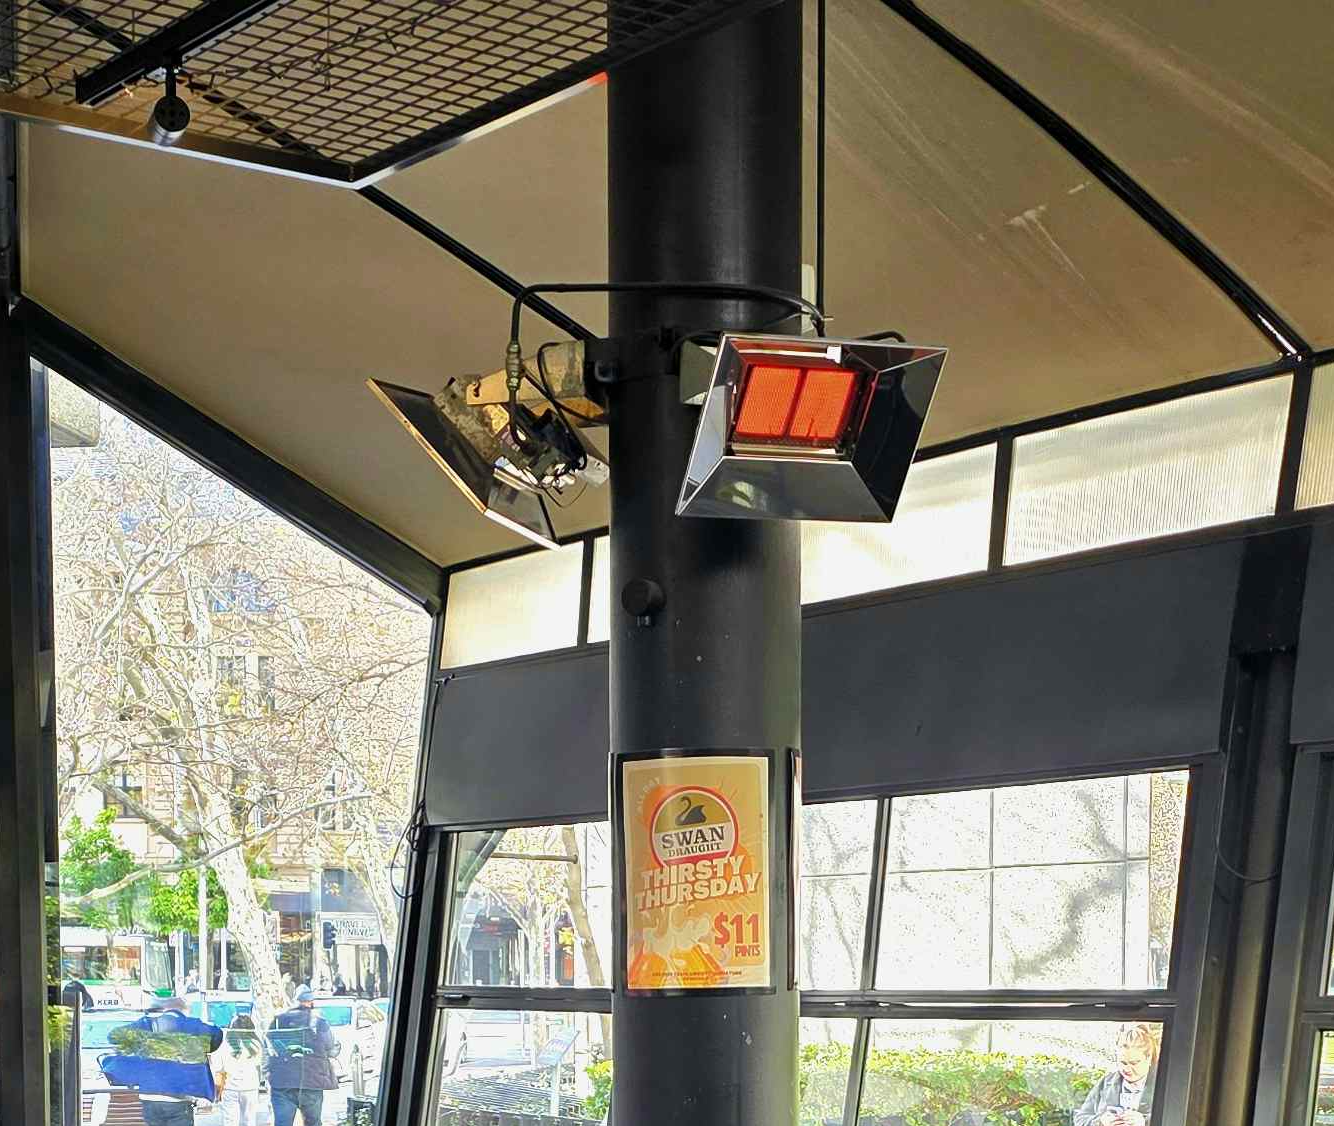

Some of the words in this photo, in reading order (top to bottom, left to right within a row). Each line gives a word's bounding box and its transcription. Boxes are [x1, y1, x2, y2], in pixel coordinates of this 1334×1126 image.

[661, 825, 725, 850] SWAN
[667, 842, 722, 857] DRAUGHT
[641, 855, 745, 887] THIRSTY
[635, 872, 762, 911] THURSDAY
[714, 911, 760, 948] $11
[735, 944, 761, 957] PINTS
